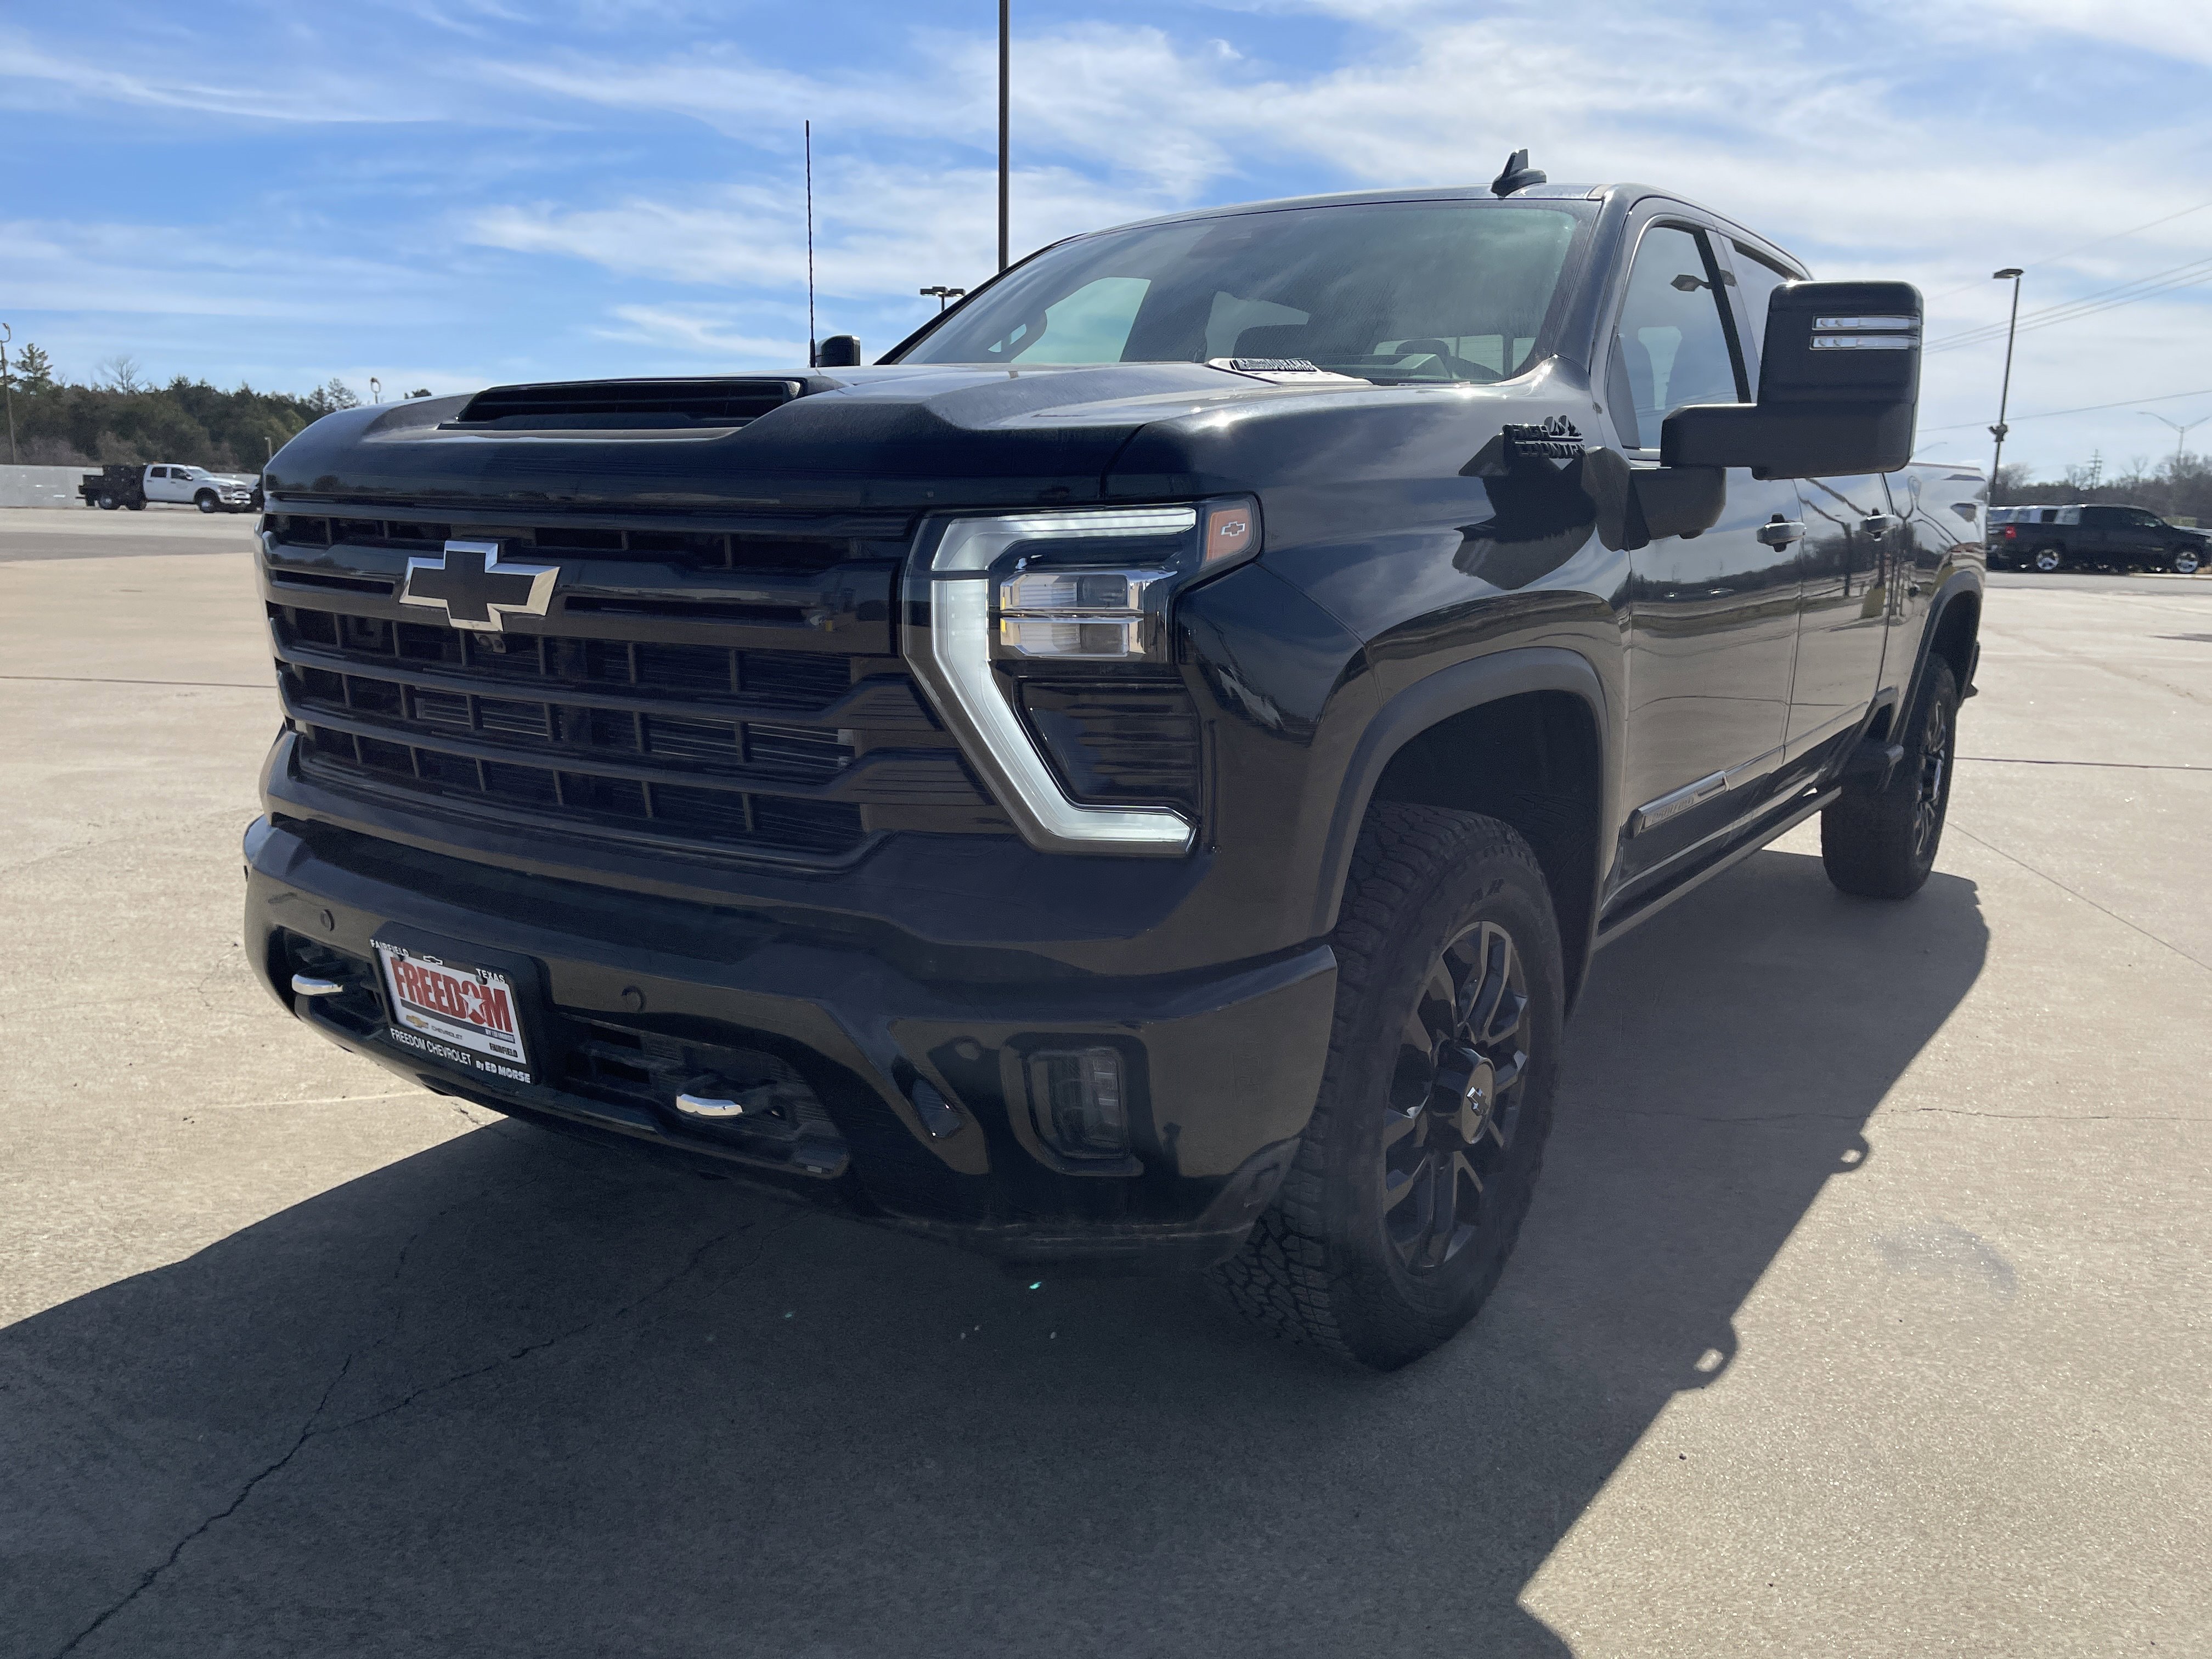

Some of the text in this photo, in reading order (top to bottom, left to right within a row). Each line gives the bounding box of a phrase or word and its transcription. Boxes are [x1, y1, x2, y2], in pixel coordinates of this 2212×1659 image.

[370, 939, 410, 957] FAIRFIELD
[476, 968, 505, 983] TEXAS
[390, 957, 513, 1032] FREEDOM
[431, 1025, 462, 1040] CHEVROLET
[390, 1028, 426, 1051] FREEDOM
[426, 1040, 472, 1066] CHEVROLET
[485, 1061, 498, 1074] ED
[498, 1065, 531, 1084] MORSE
